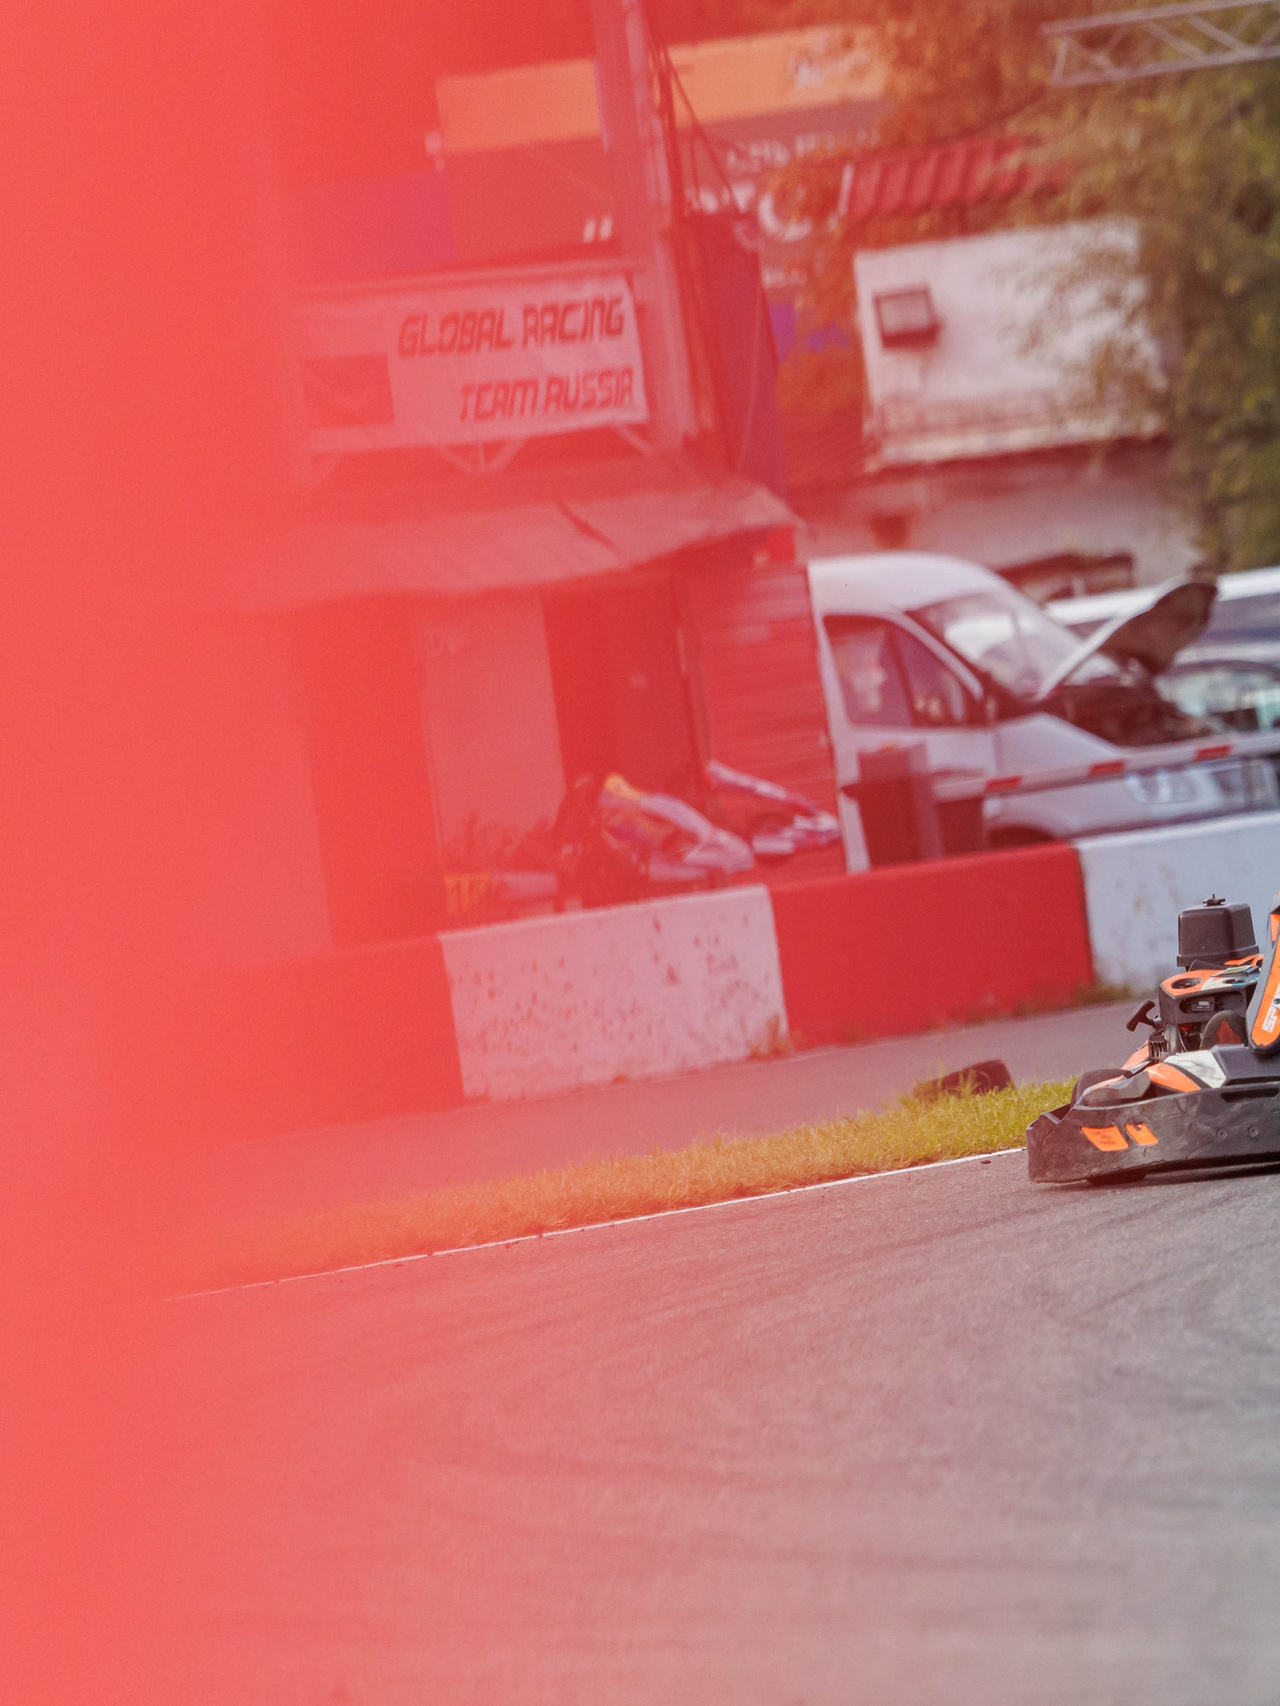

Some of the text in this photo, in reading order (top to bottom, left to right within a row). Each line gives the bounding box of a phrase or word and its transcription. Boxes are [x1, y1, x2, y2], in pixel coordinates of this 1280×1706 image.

[400, 298, 624, 356] GLOBAL RACING
[461, 368, 634, 422] TEAM RUSSIA
